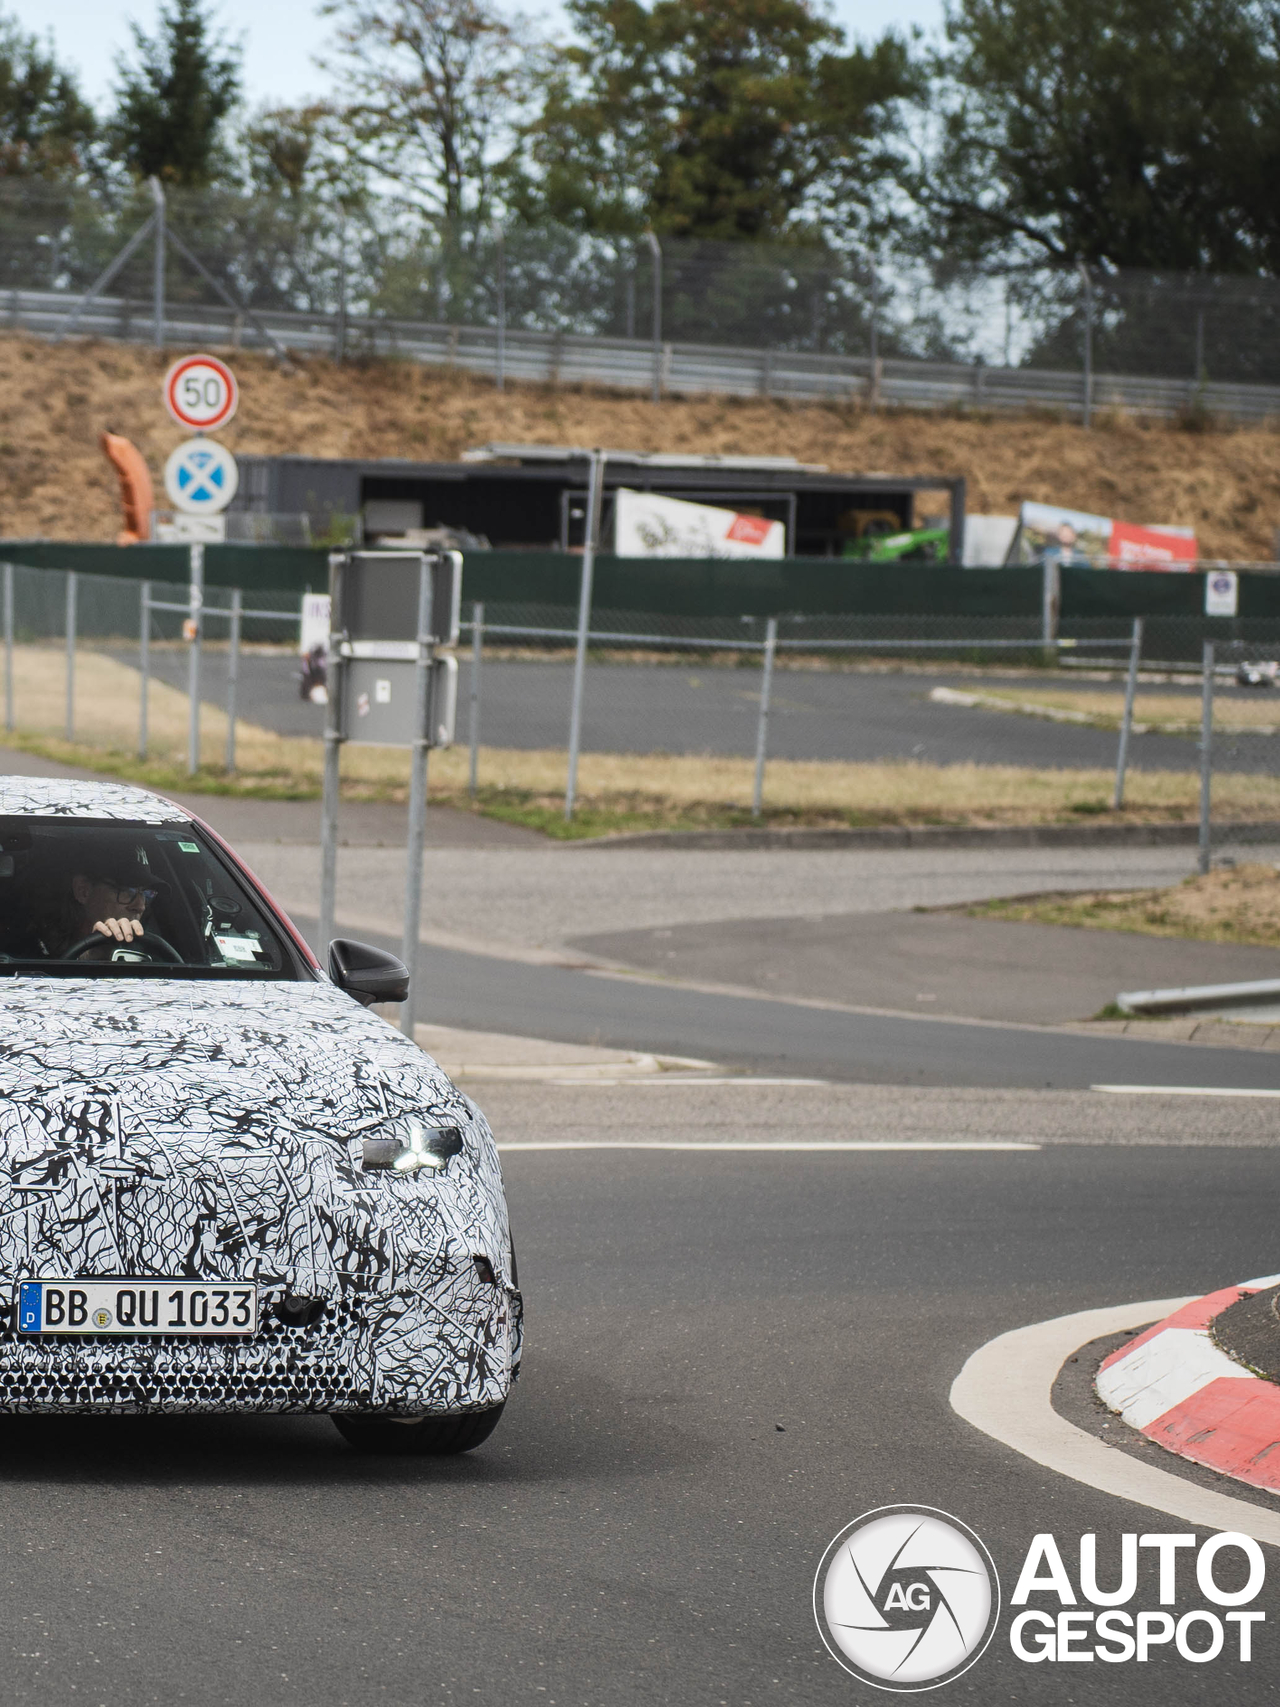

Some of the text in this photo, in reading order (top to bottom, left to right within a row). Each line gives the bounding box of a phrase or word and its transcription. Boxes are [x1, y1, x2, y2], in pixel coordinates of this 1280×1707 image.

[184, 377, 220, 408] 50
[25, 1312, 35, 1323] D
[45, 1289, 251, 1327] BB QU 1033
